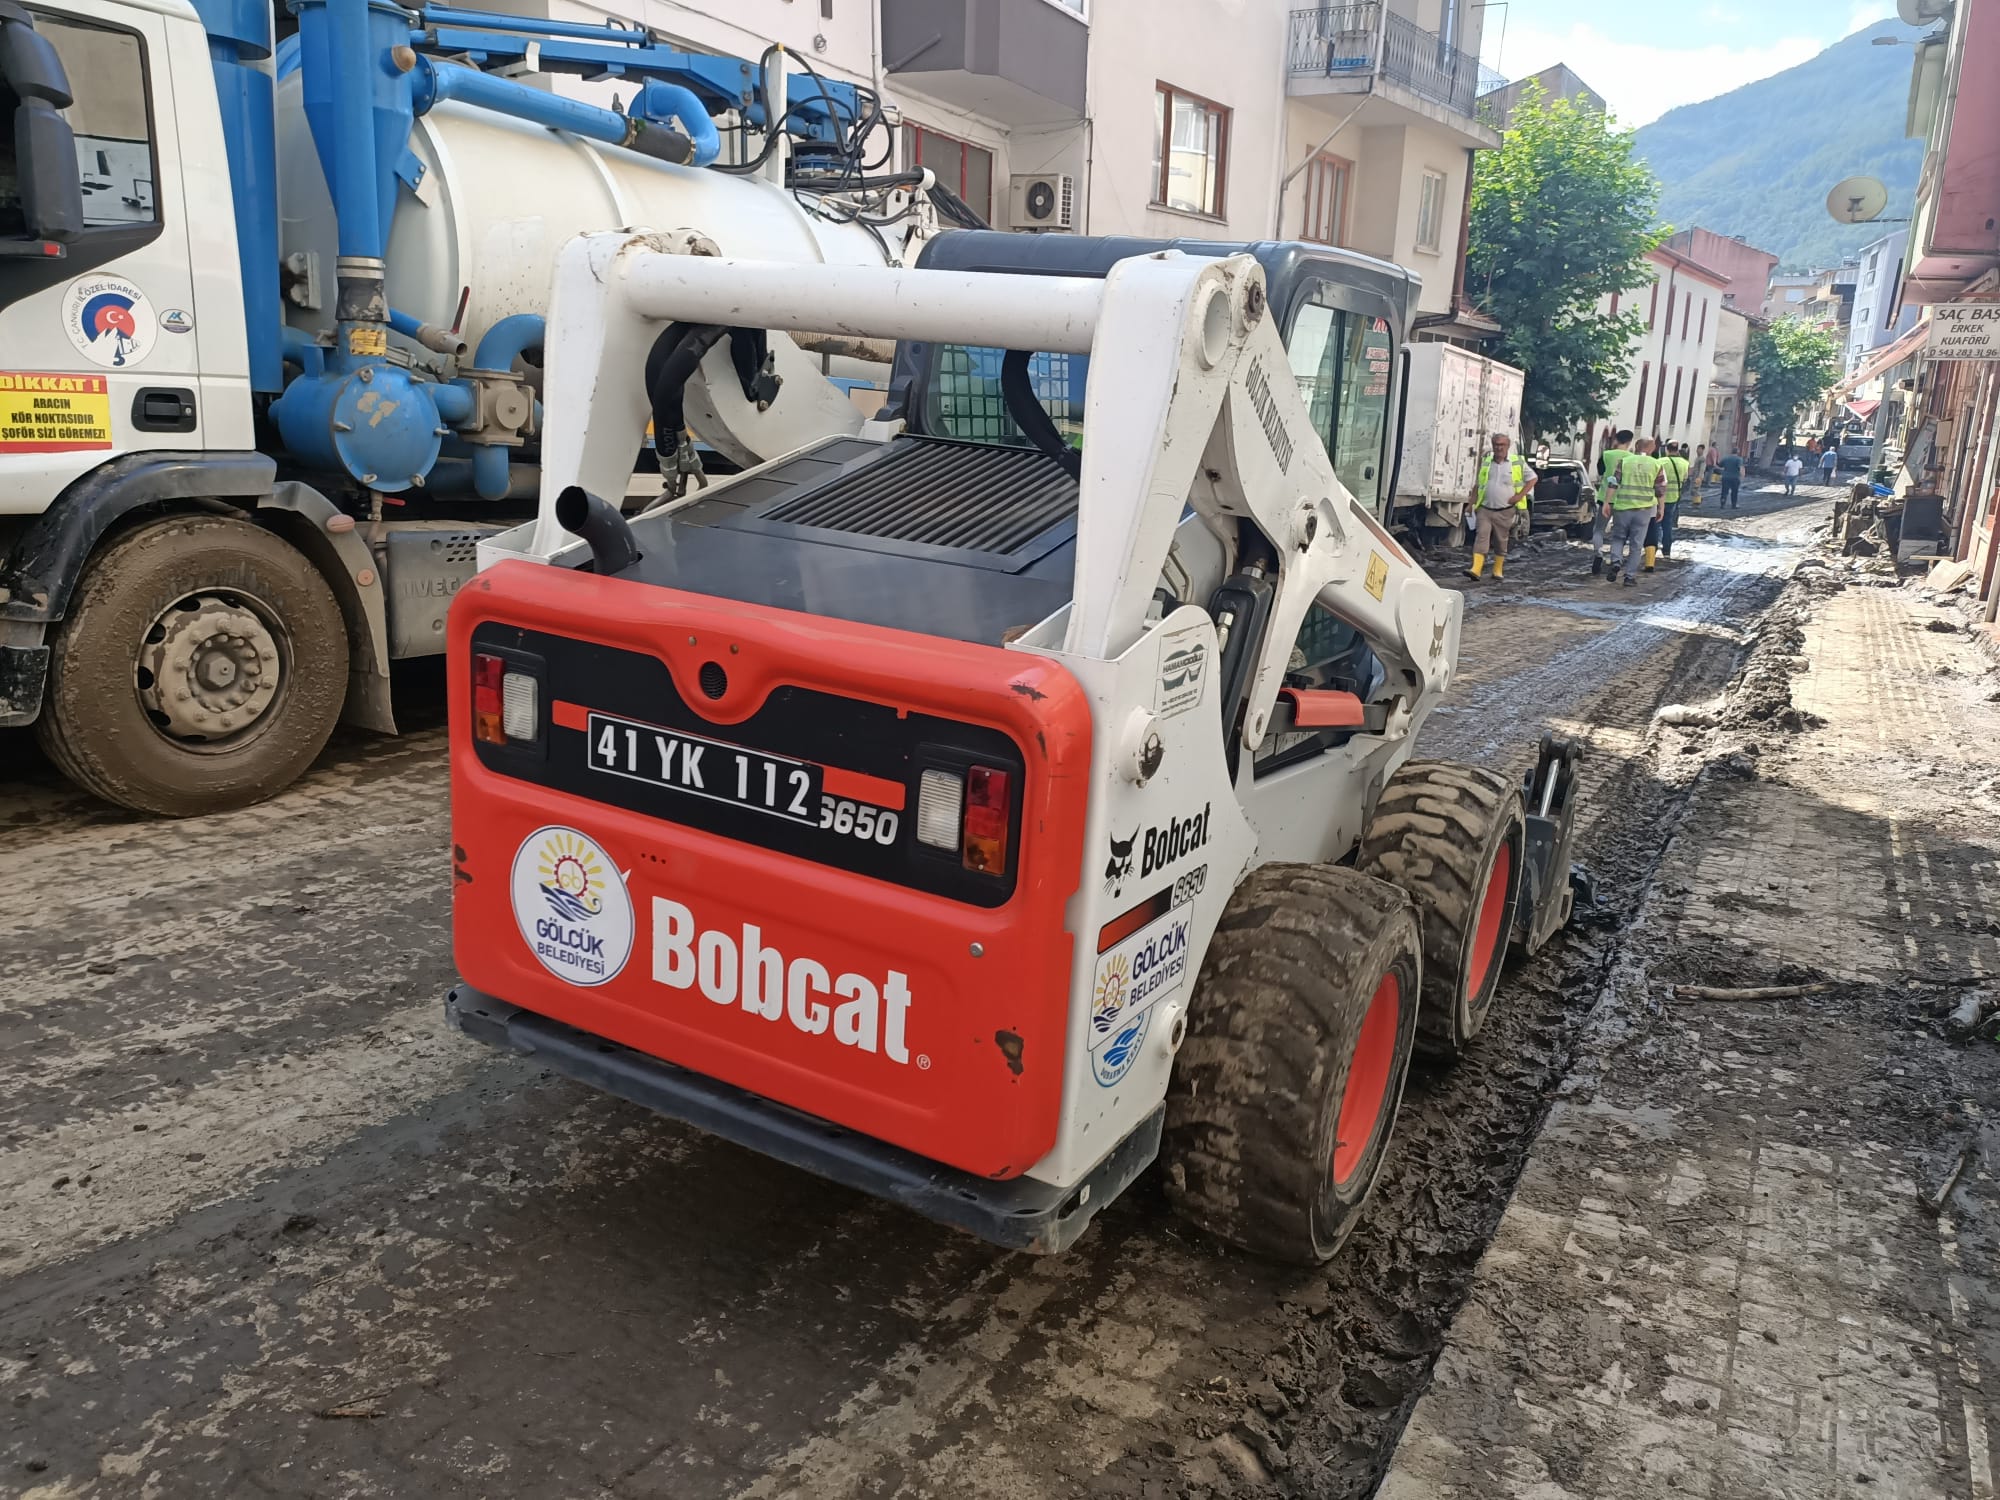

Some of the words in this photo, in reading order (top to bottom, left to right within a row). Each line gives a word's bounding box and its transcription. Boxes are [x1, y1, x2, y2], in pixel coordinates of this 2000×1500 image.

[85, 283, 106, 296] ÖZEL
[107, 282, 142, 300] İDARESİ
[1936, 309, 1967, 323] SAÇ
[1971, 309, 2000, 323] BAŞ
[1950, 324, 1984, 333] ERKEK
[1940, 335, 1990, 345] KUAFÖRÜ
[0, 374, 86, 392] DİKKAT
[11, 411, 32, 423] KÖR
[35, 413, 94, 424] NOKTASIDIR
[33, 398, 71, 409] ARACIN
[1246, 353, 1270, 422] GÖLCÜK
[1262, 397, 1296, 476] BELEDİYESİ
[2, 427, 35, 440] ŞOFÖR
[37, 426, 56, 439] SİZİ
[403, 576, 461, 598] IVEC
[598, 725, 637, 771] 41
[655, 735, 705, 788] YK
[735, 755, 811, 816] 112
[820, 796, 899, 845] S650
[1140, 801, 1211, 880] Bobcat
[1172, 864, 1208, 909] S650
[536, 917, 605, 959] GÖLCÜK
[1132, 920, 1188, 980] GÖLCÜK
[537, 942, 605, 976] BELEDİYESİ
[652, 895, 912, 1065] Bobcat
[1129, 952, 1186, 1007] BELEDİYESİ
